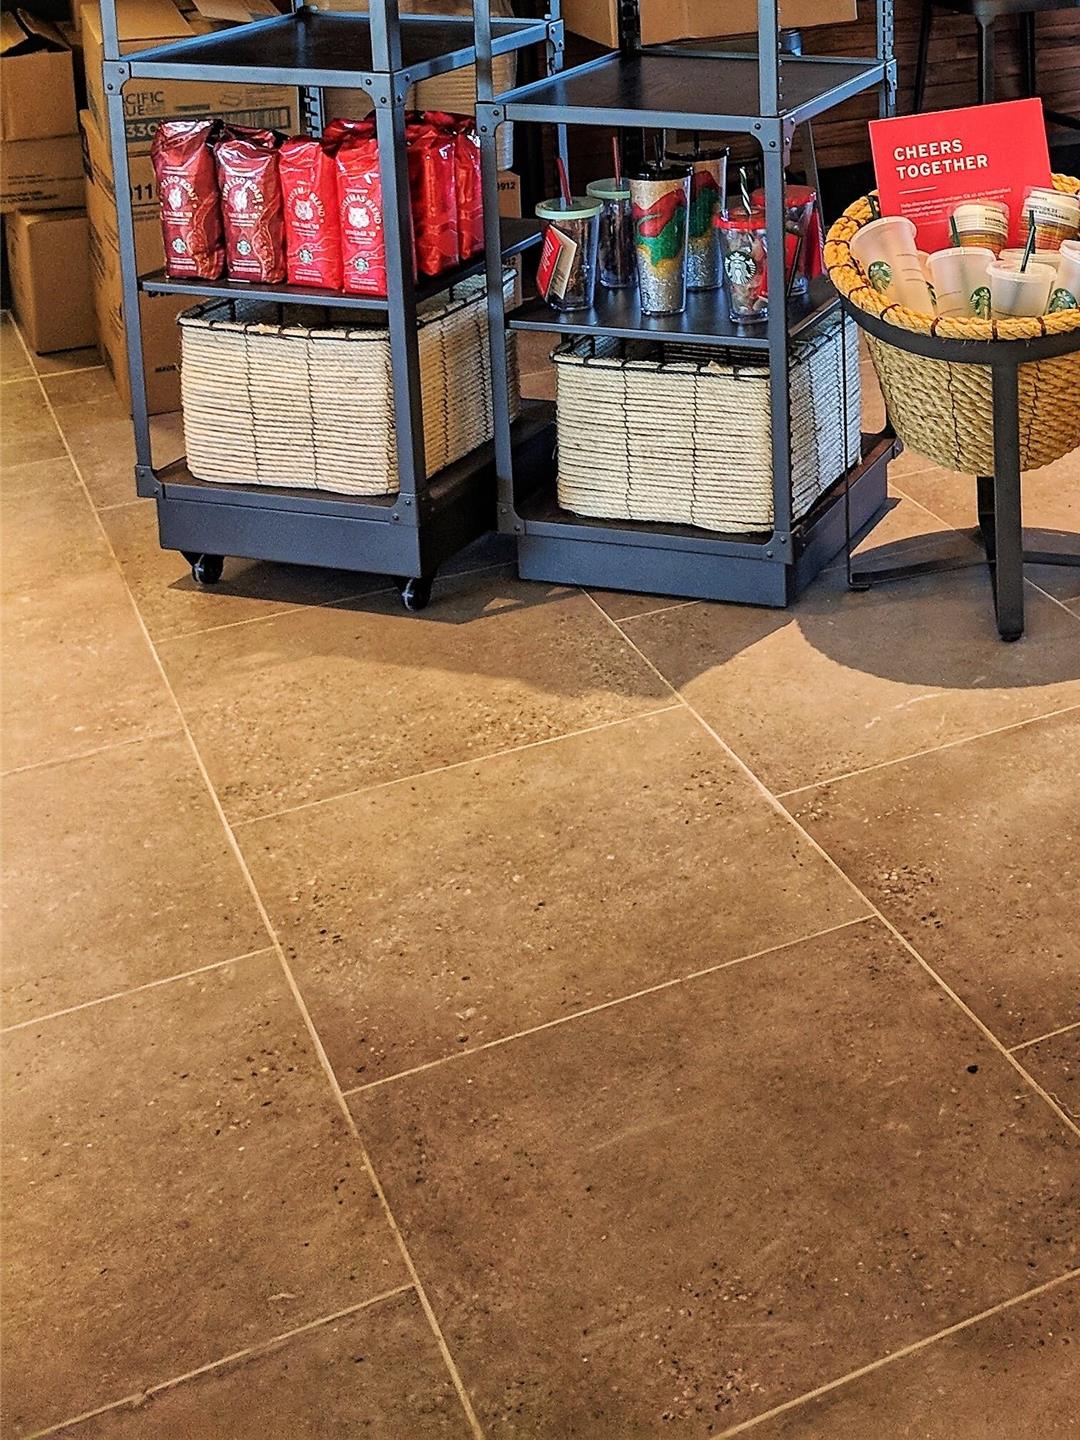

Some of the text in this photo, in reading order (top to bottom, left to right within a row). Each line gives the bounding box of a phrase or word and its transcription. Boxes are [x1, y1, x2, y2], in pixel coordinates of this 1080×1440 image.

[126, 91, 164, 105] CIFIC
[894, 139, 963, 161] CHEERS
[896, 154, 988, 180] TOGETHER
